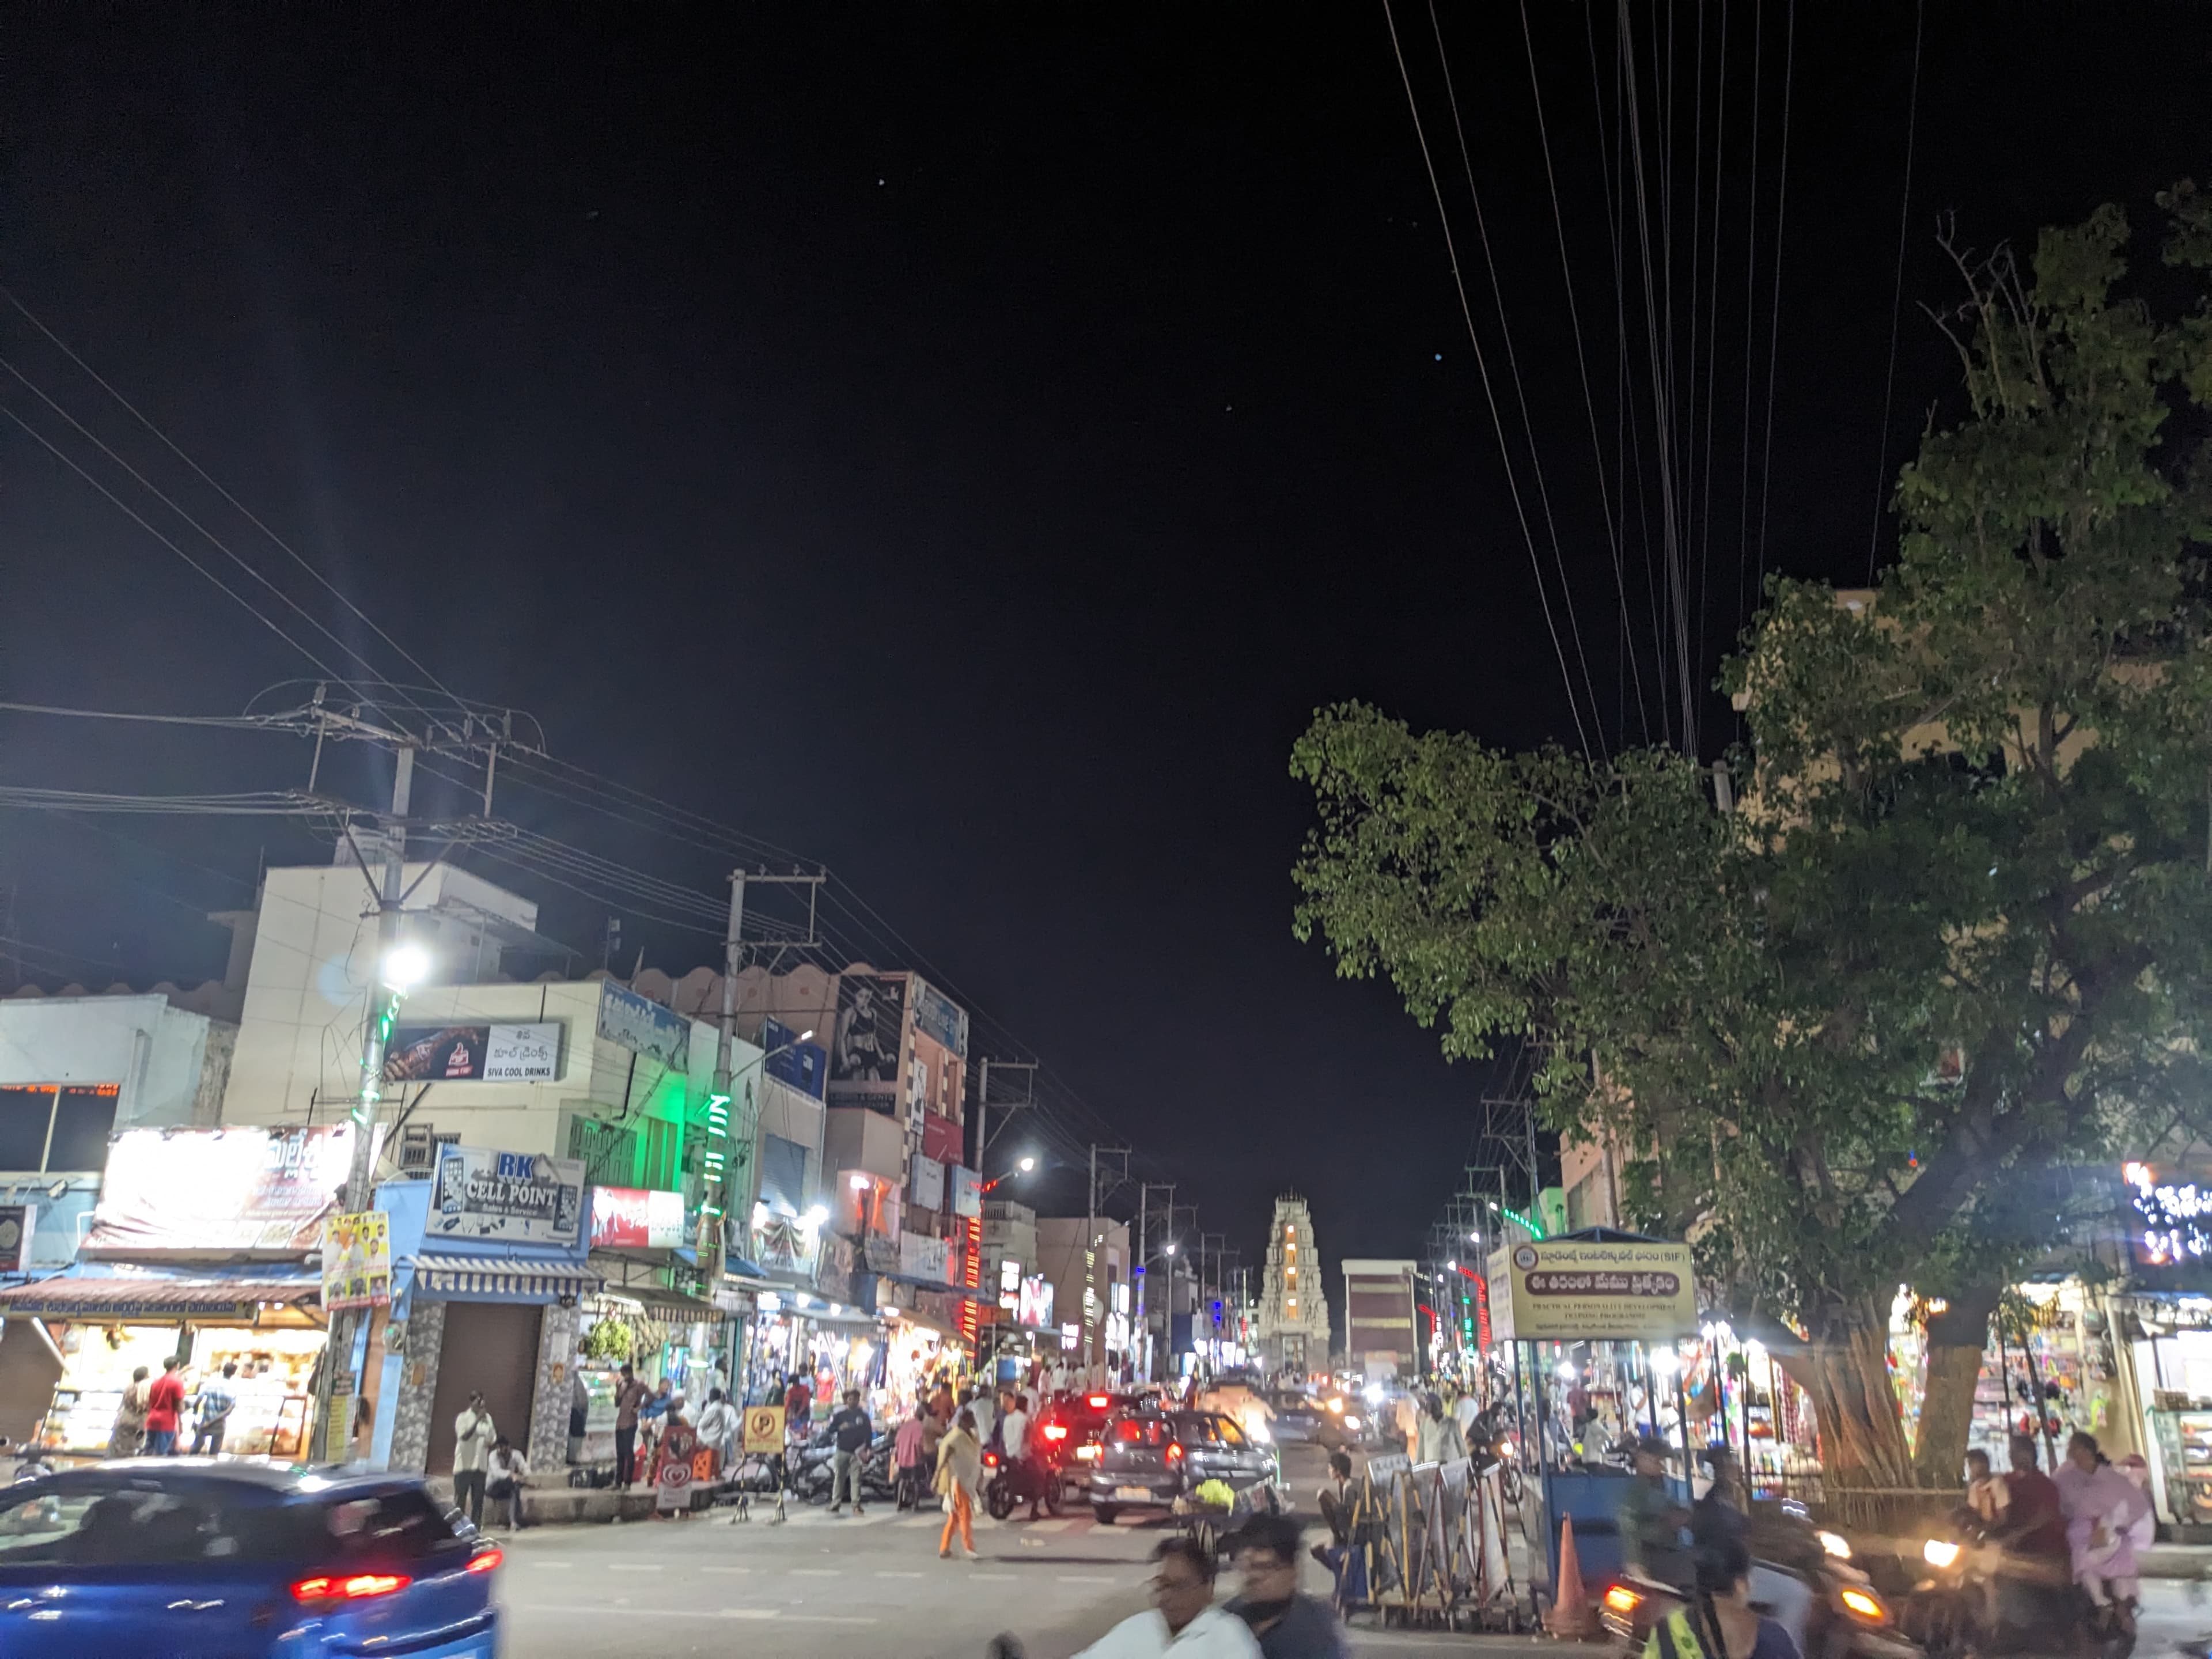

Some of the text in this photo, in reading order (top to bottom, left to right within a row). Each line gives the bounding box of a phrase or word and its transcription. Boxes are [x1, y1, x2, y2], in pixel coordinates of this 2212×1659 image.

[487, 1067, 551, 1077] SIVA COOL DRINKS
[497, 1152, 536, 1182] RK
[467, 1180, 557, 1207] CELL POINT
[510, 1206, 538, 1217] Service
